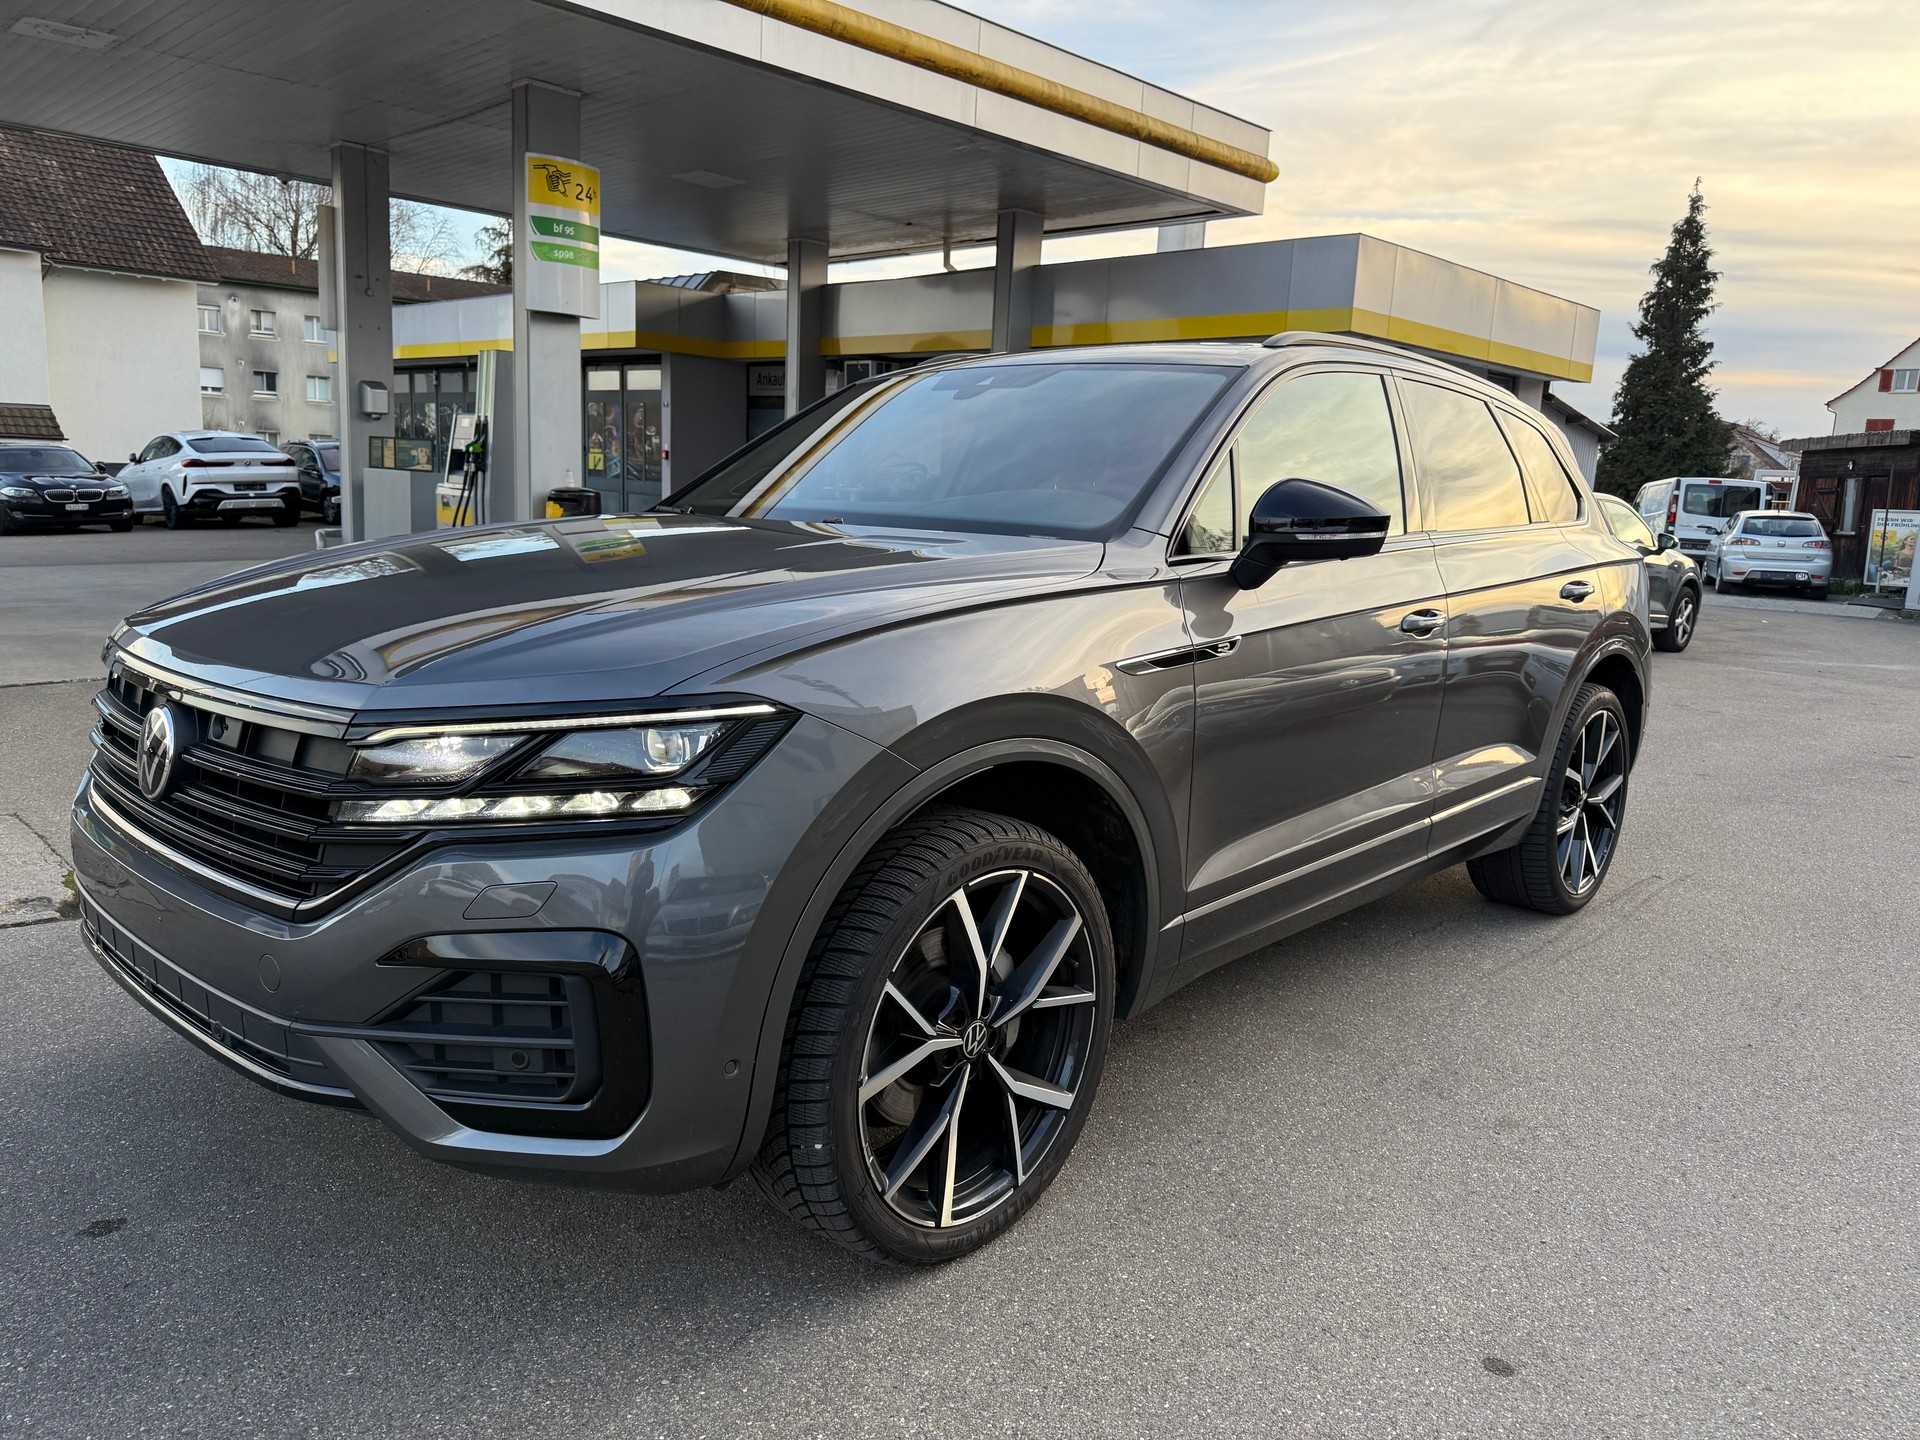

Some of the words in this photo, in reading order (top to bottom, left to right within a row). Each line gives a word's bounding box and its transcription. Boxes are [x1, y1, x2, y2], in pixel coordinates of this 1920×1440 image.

[553, 222, 563, 233] bf
[565, 226, 575, 235] 95
[553, 250, 574, 259] sp98
[947, 846, 1043, 886] GOODYEAR
